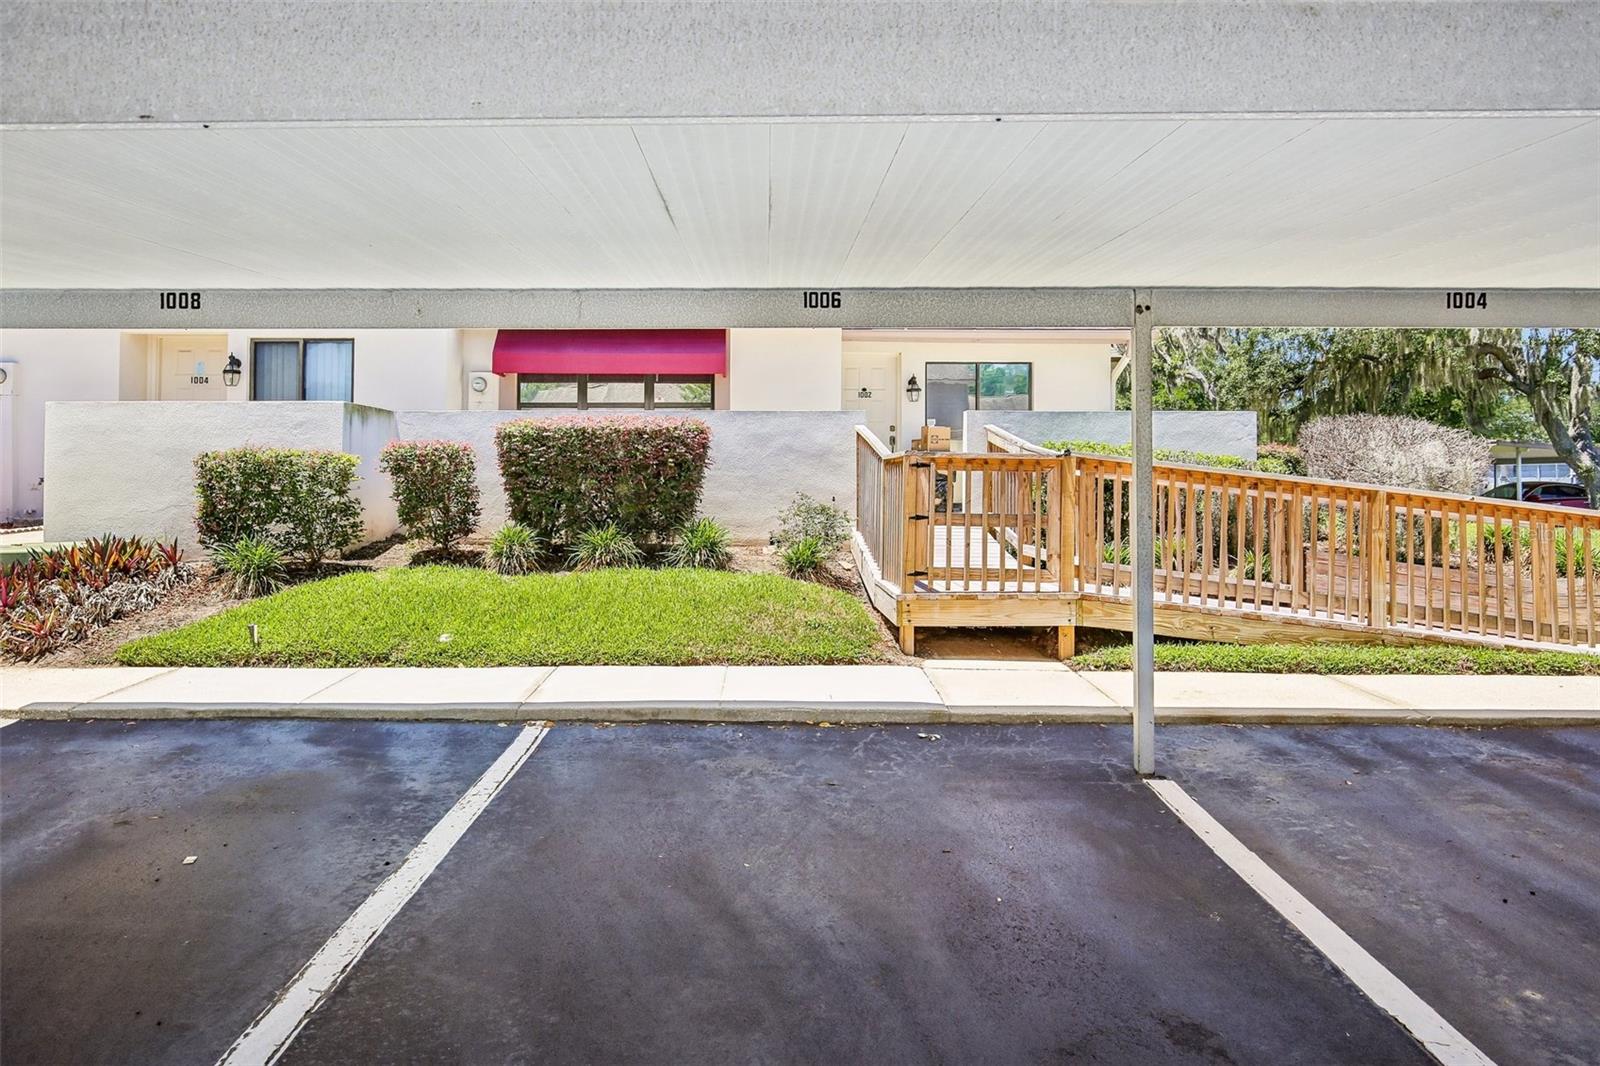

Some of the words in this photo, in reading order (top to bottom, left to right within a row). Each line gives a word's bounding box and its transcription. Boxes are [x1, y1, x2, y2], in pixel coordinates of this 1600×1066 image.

[160, 292, 201, 309] 1008
[803, 291, 841, 308] 1006
[1446, 292, 1487, 309] 1004
[190, 376, 209, 384] 1004
